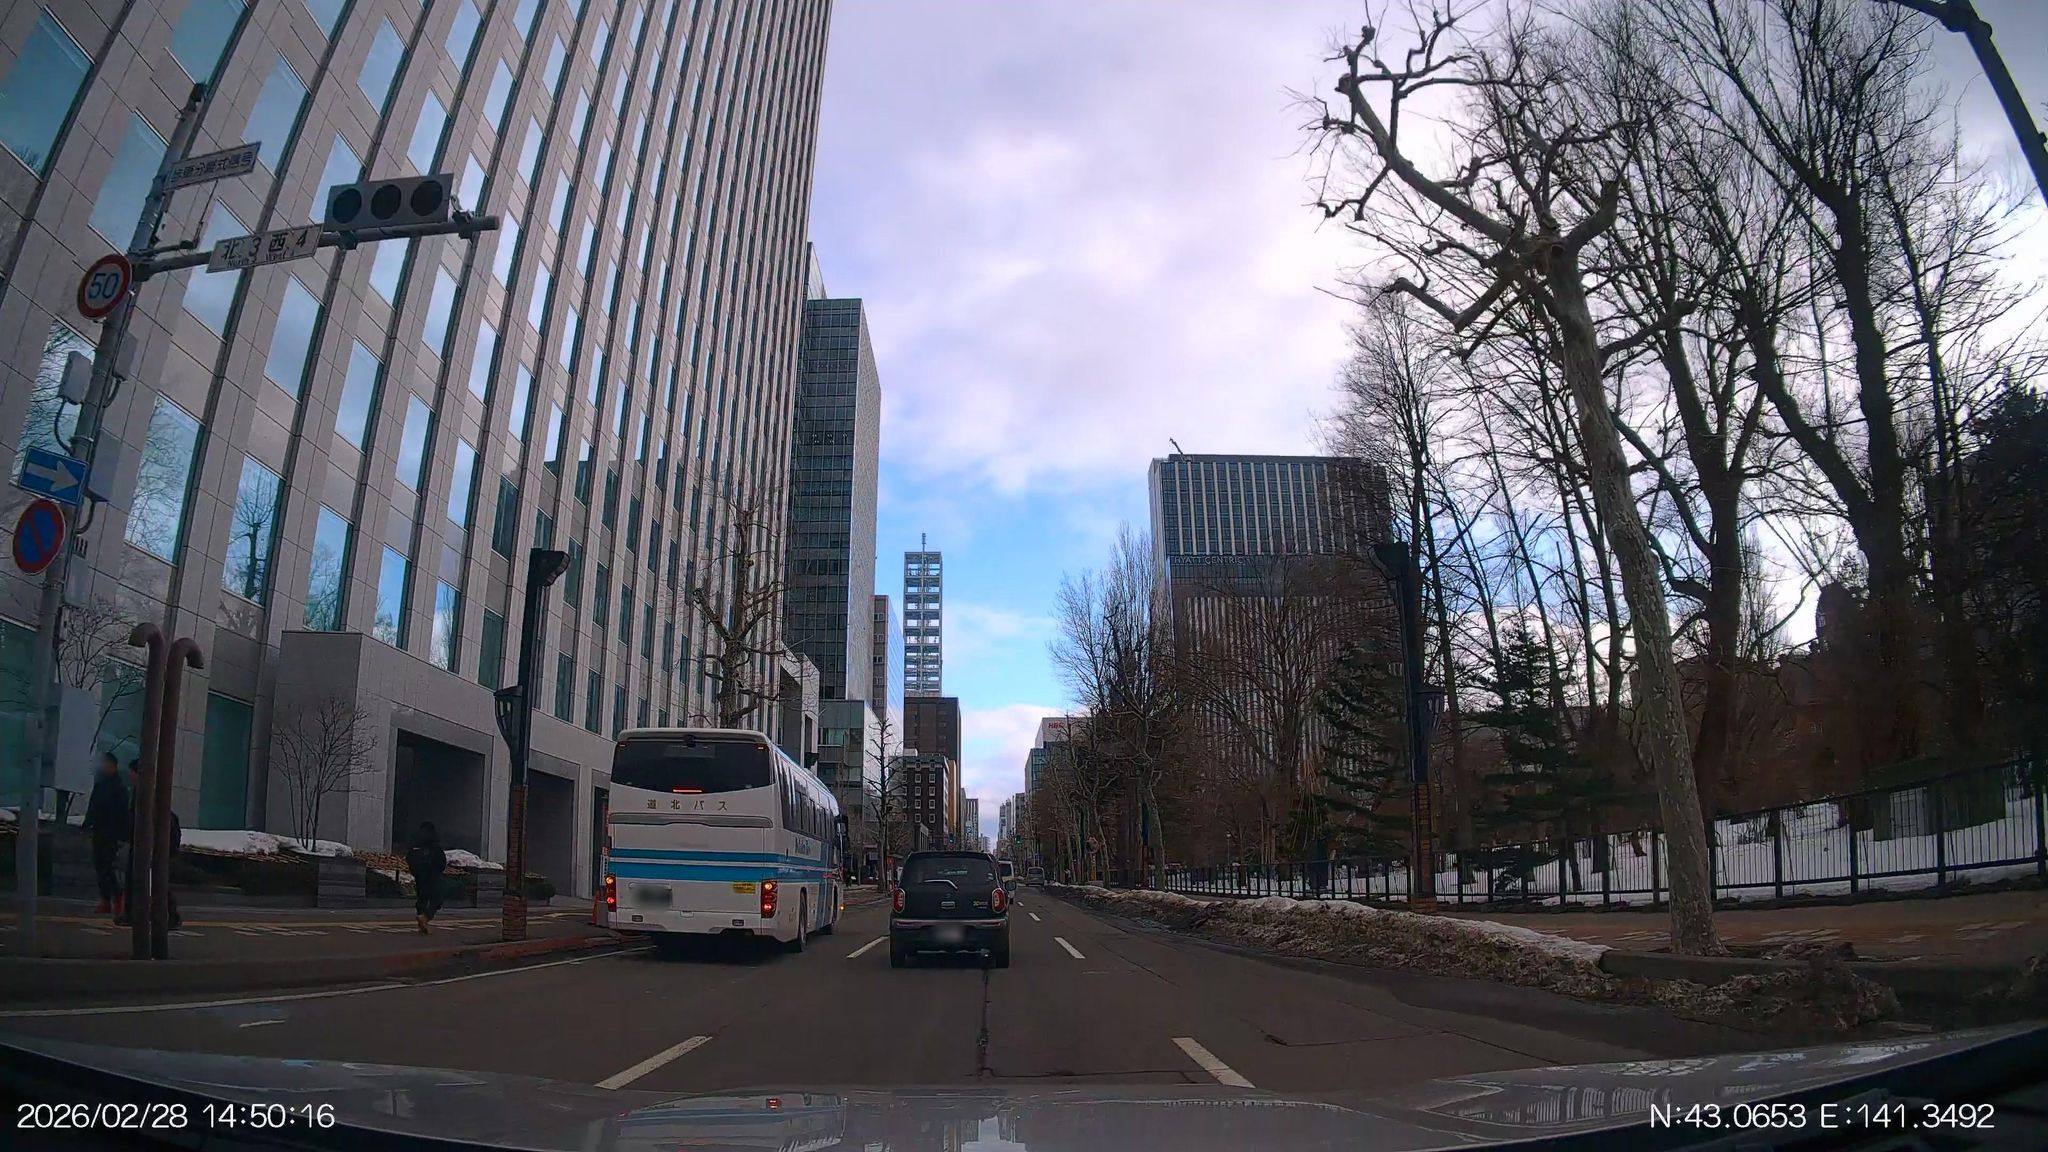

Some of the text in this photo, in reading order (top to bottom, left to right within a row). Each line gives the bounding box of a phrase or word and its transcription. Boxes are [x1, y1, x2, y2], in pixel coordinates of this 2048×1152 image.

[88, 272, 119, 299] 50
[1174, 556, 1244, 564] HYATT CENTRIC
[647, 799, 727, 811] 道北バス
